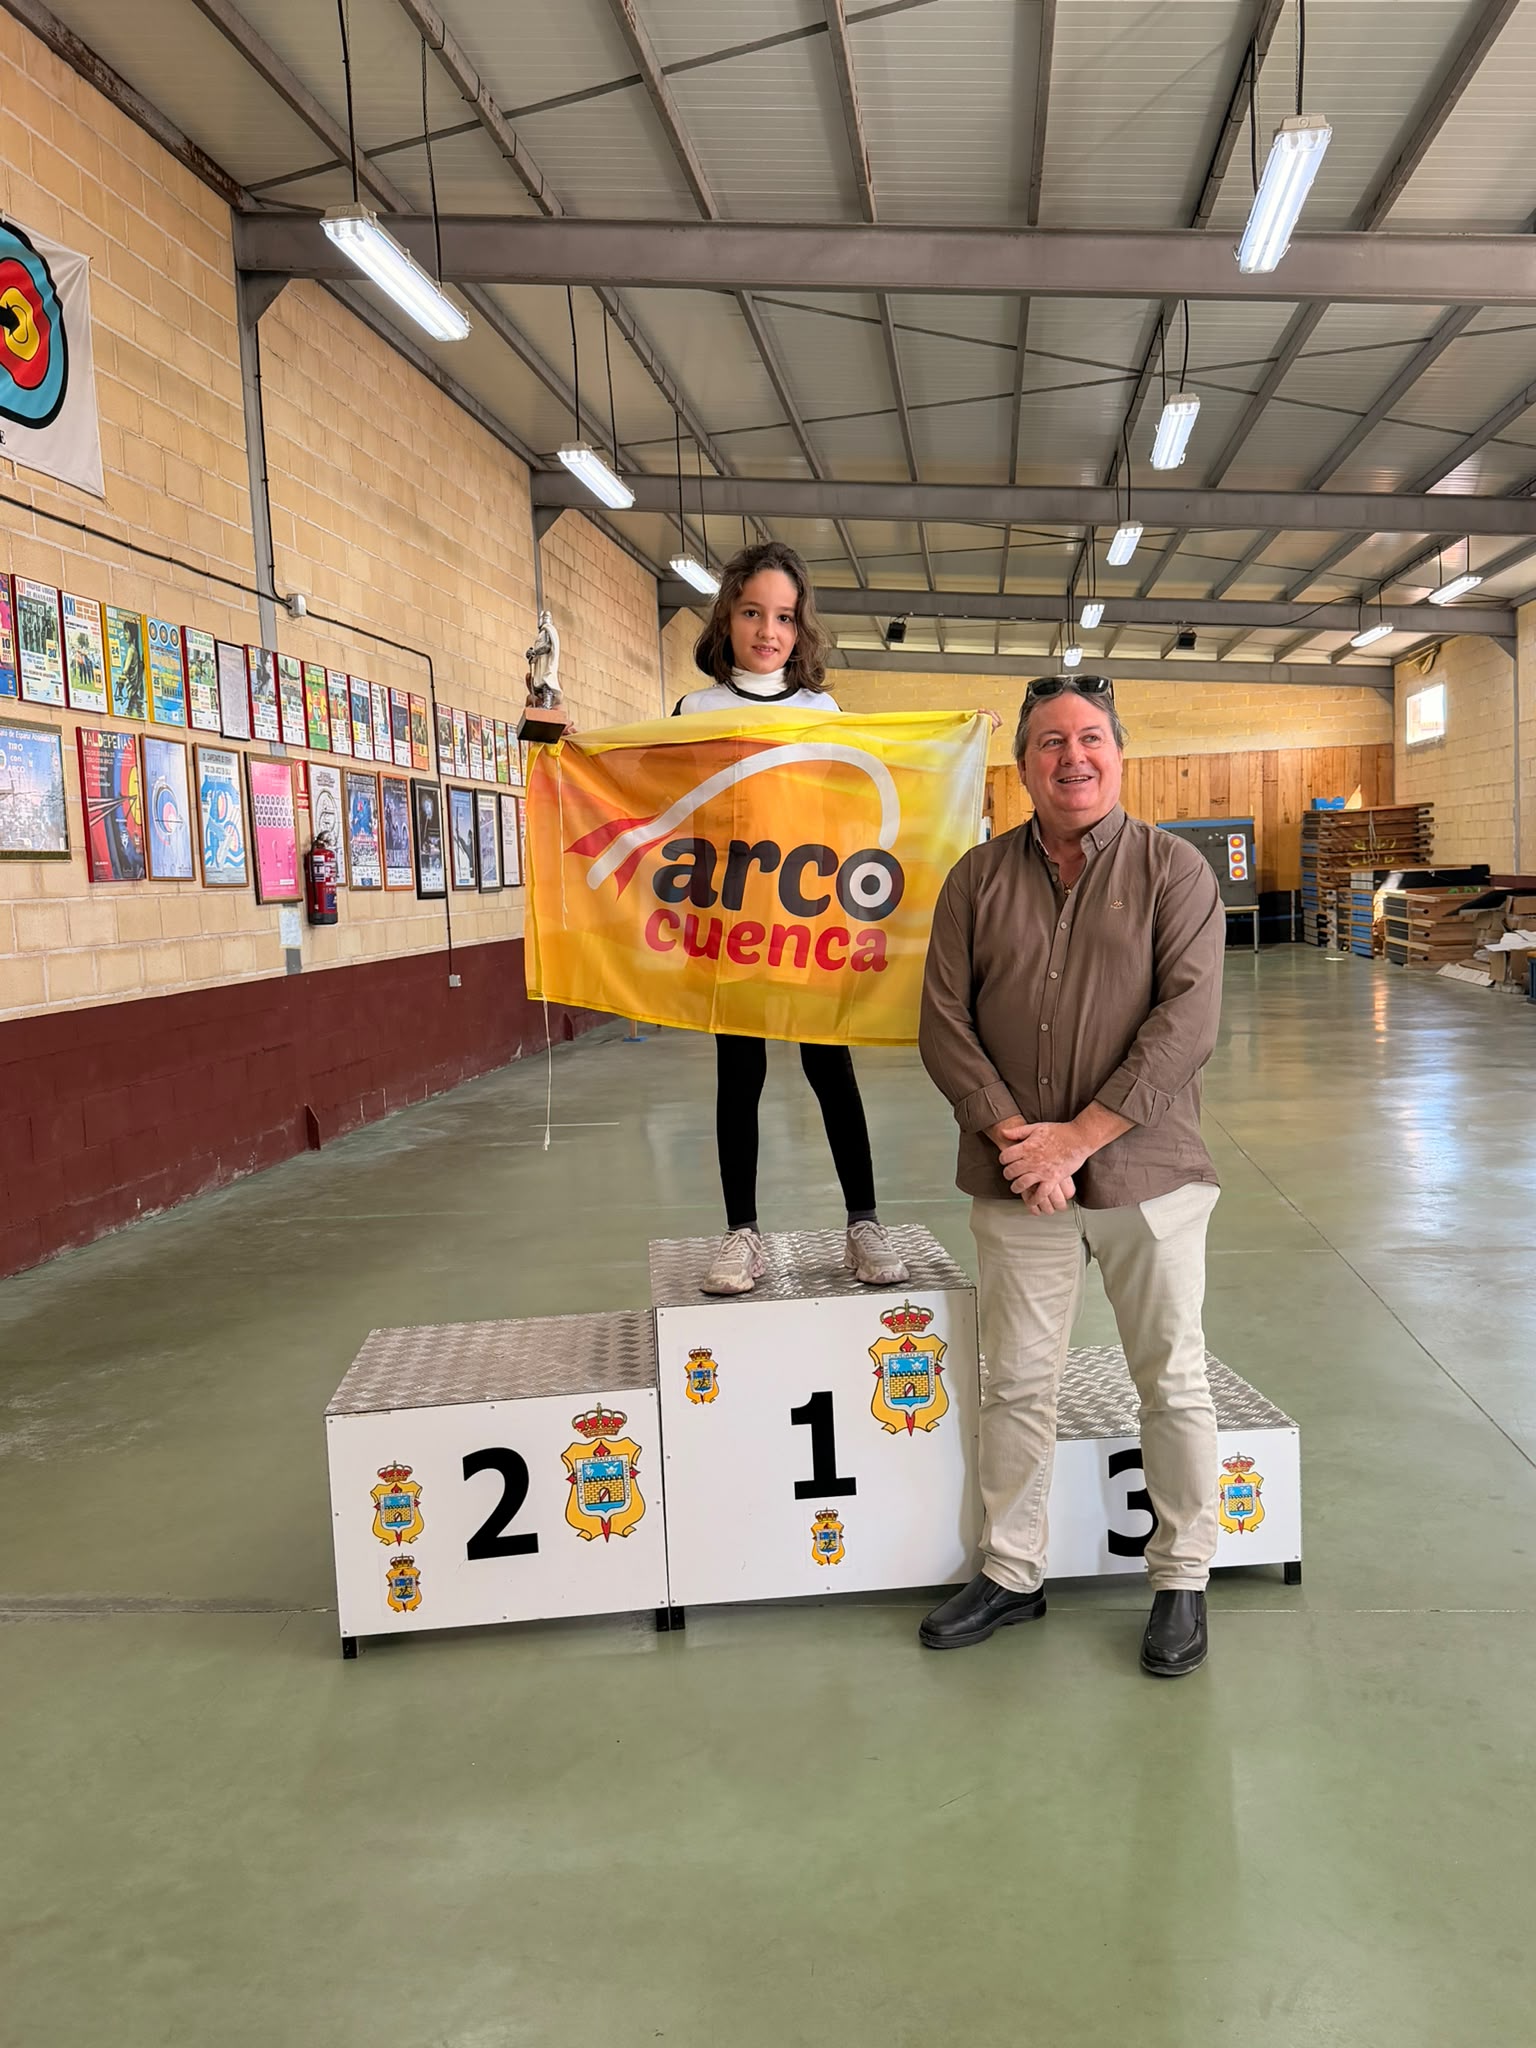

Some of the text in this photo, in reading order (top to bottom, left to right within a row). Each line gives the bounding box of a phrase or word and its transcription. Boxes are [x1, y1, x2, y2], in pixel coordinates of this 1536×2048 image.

[2, 638, 11, 649] 10
[8, 742, 23, 751] TIRO
[82, 731, 133, 751] VALDEPEÑAS
[652, 837, 905, 921] arco
[645, 908, 888, 973] cuenca
[791, 1391, 857, 1500] 1
[462, 1447, 539, 1561] 2
[1108, 1448, 1159, 1557] 3
